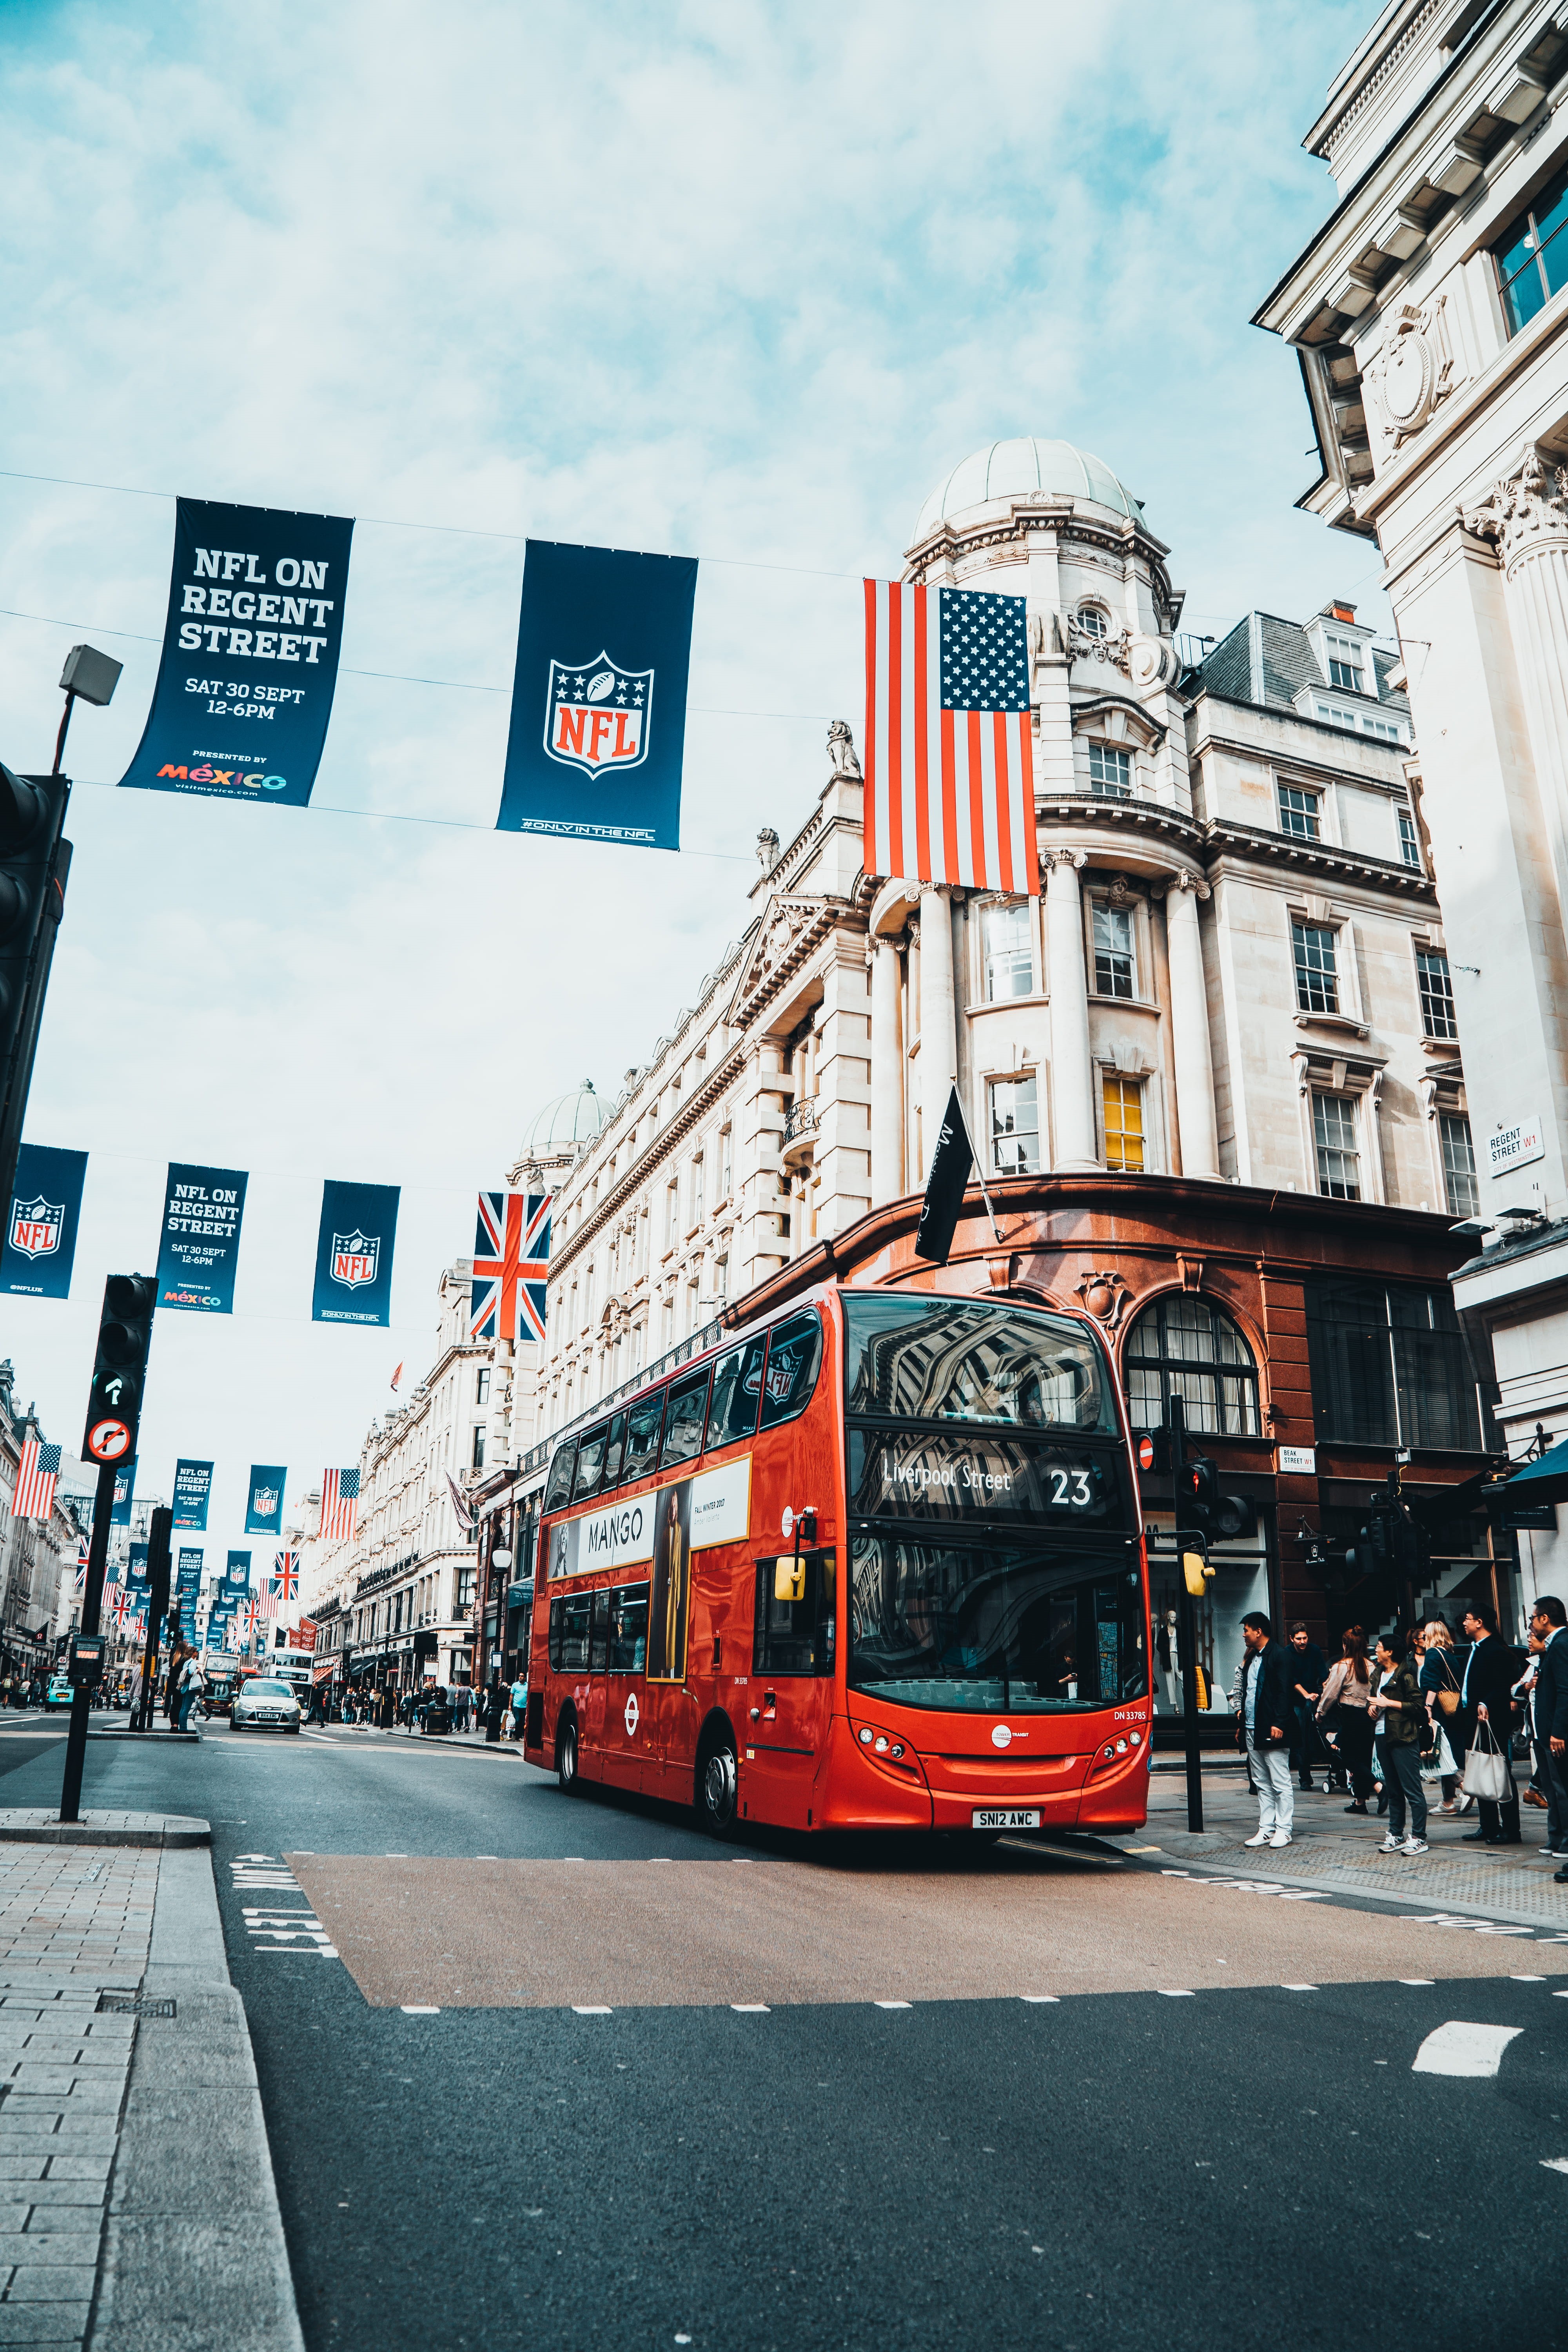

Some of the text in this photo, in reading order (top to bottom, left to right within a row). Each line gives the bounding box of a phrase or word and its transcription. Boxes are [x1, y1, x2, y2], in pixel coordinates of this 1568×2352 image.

[194, 548, 328, 590] NFL ON
[180, 585, 333, 627] REGENT
[178, 623, 327, 663] STREET
[185, 679, 305, 704] SAT 30 SEPT
[207, 700, 275, 719] 12-6PM
[556, 707, 636, 762] NFL
[193, 750, 251, 762] PRESENTED
[176, 783, 257, 796] visitmexico.com
[523, 821, 573, 831] #ONLY
[592, 828, 622, 837] THE
[624, 830, 654, 839] NFL
[1491, 1127, 1520, 1149] REGENT
[1492, 1134, 1535, 1161] STREET W1
[1509, 1152, 1534, 1166] WESTMINSTER
[175, 1184, 237, 1203] NFL ON
[169, 1200, 239, 1220] REGENT
[15, 1222, 53, 1250] NFL
[168, 1217, 236, 1237] STREET
[171, 1244, 226, 1257] SAT 30 SEPT
[181, 1255, 213, 1265] 12-6PM
[336, 1255, 372, 1281] NFL
[10, 1285, 44, 1293] @NFLUK
[177, 1475, 210, 1485] REGENT
[884, 1459, 1011, 1491] Liverpool Street
[113, 1489, 123, 1500] FL
[176, 1483, 209, 1492] STREET
[1051, 1469, 1091, 1506] 23
[257, 1500, 273, 1512] NFL
[703, 1501, 716, 1512] WINTER
[717, 1499, 725, 1508] 2017
[588, 1507, 643, 1553] MANGO
[1114, 1711, 1146, 1720] DN 33785
[980, 1813, 1032, 1826] SN12 AWC
